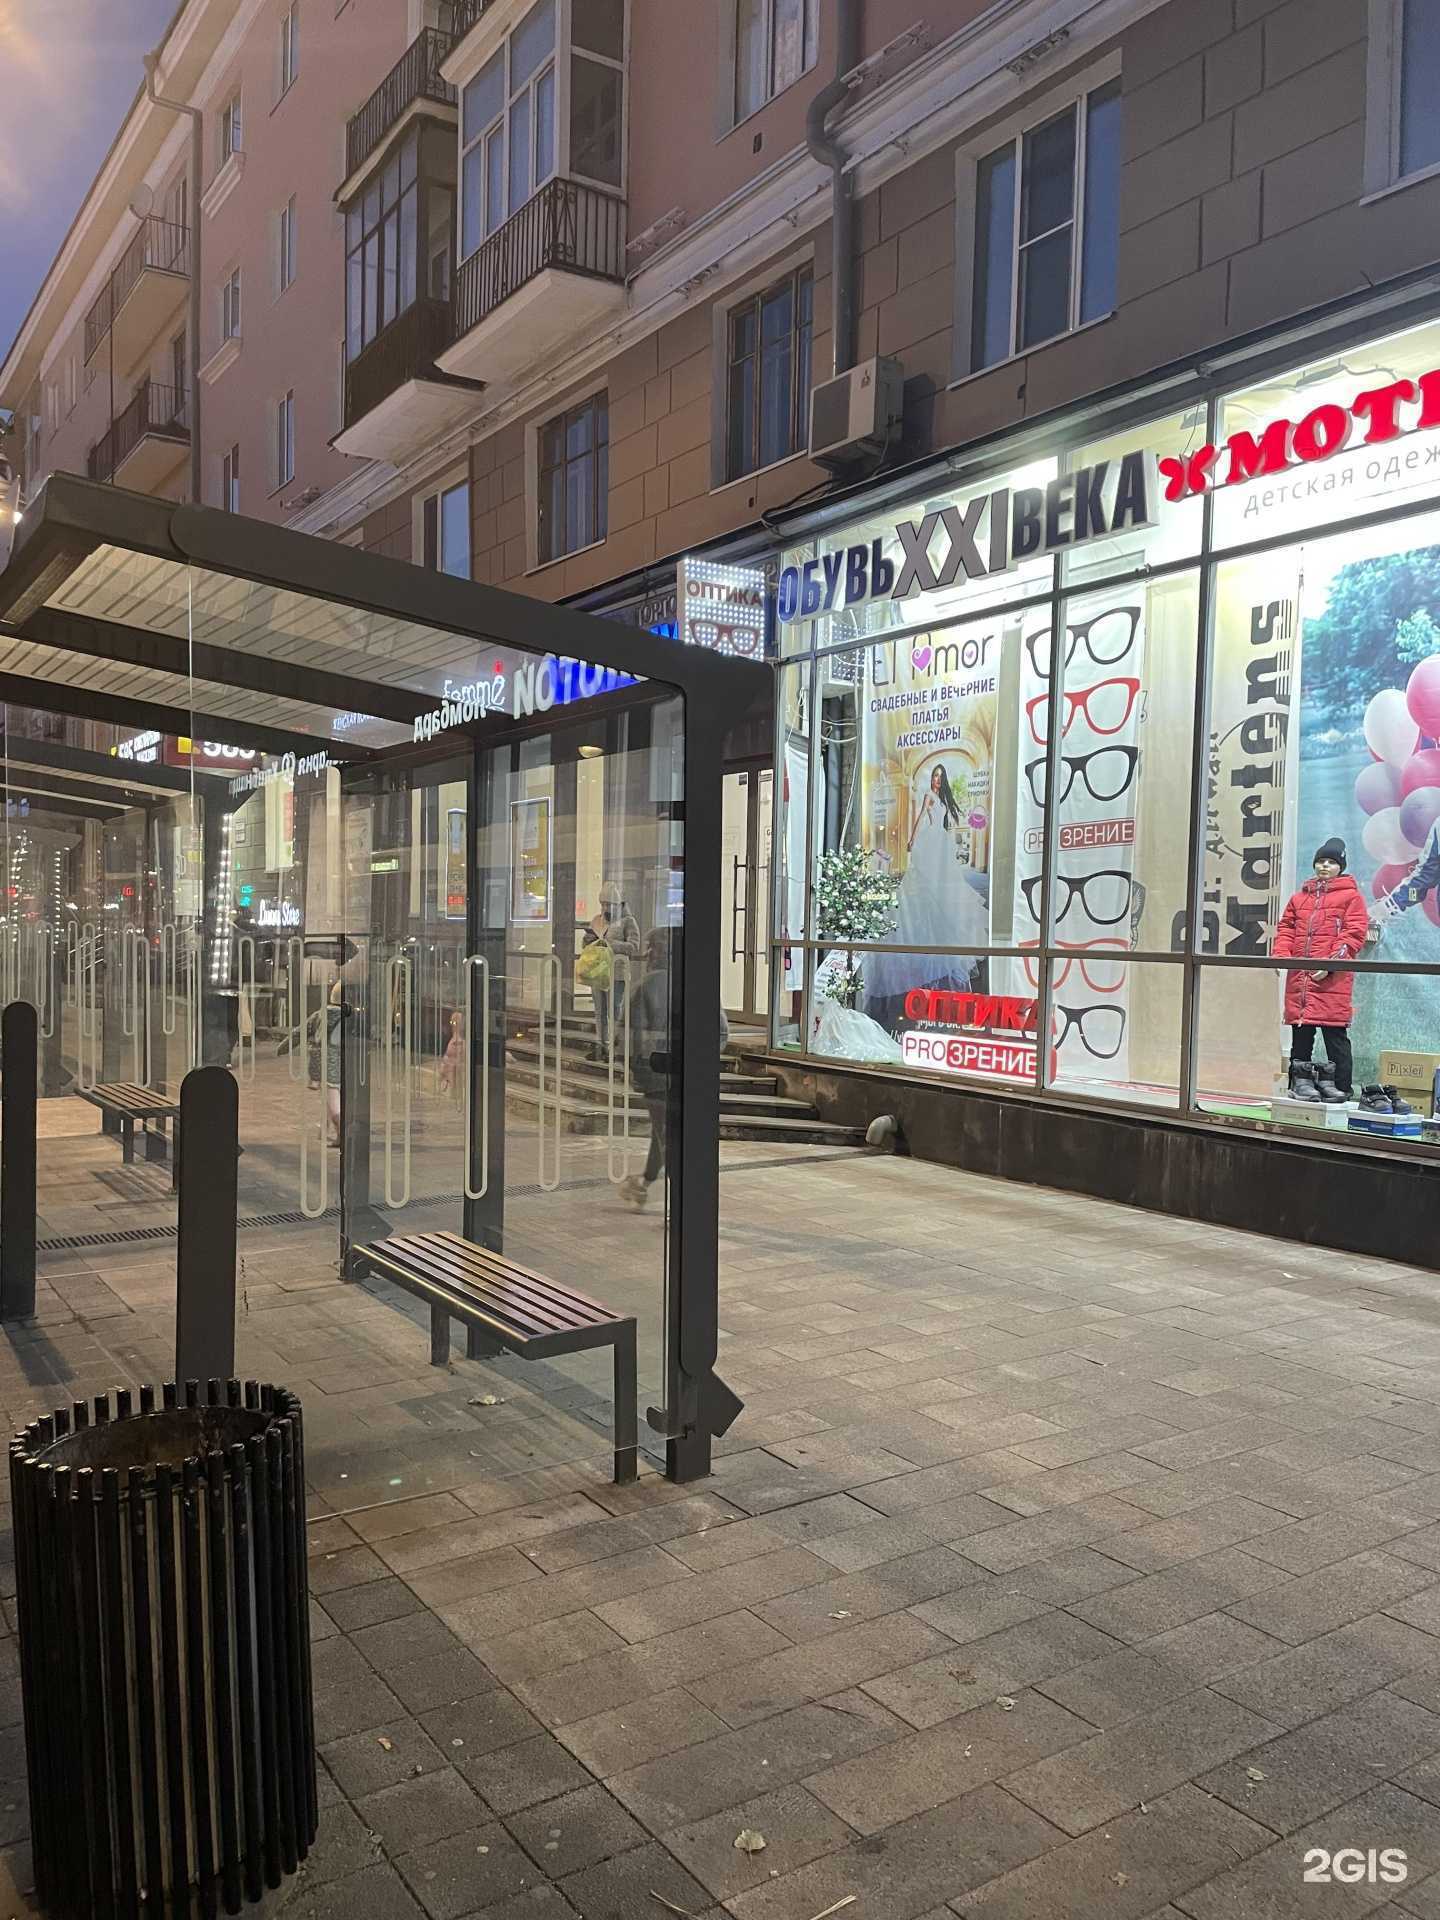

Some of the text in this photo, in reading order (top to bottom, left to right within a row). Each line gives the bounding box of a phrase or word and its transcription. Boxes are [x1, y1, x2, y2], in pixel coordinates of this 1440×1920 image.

[1243, 468, 1353, 518] детская
[778, 538, 894, 623] ОБУВЬ
[1011, 449, 1148, 558] ВЕКА
[686, 579, 763, 606] ОПТИКА
[870, 677, 996, 713] СВАДЕБНЫЕ И ВЕЧЕРНИЕ
[912, 707, 949, 726] ПЛАТЬЯ
[896, 726, 961, 749] АКСЕССУАРЫ
[1062, 822, 1134, 847] ЗРЕНИЕ
